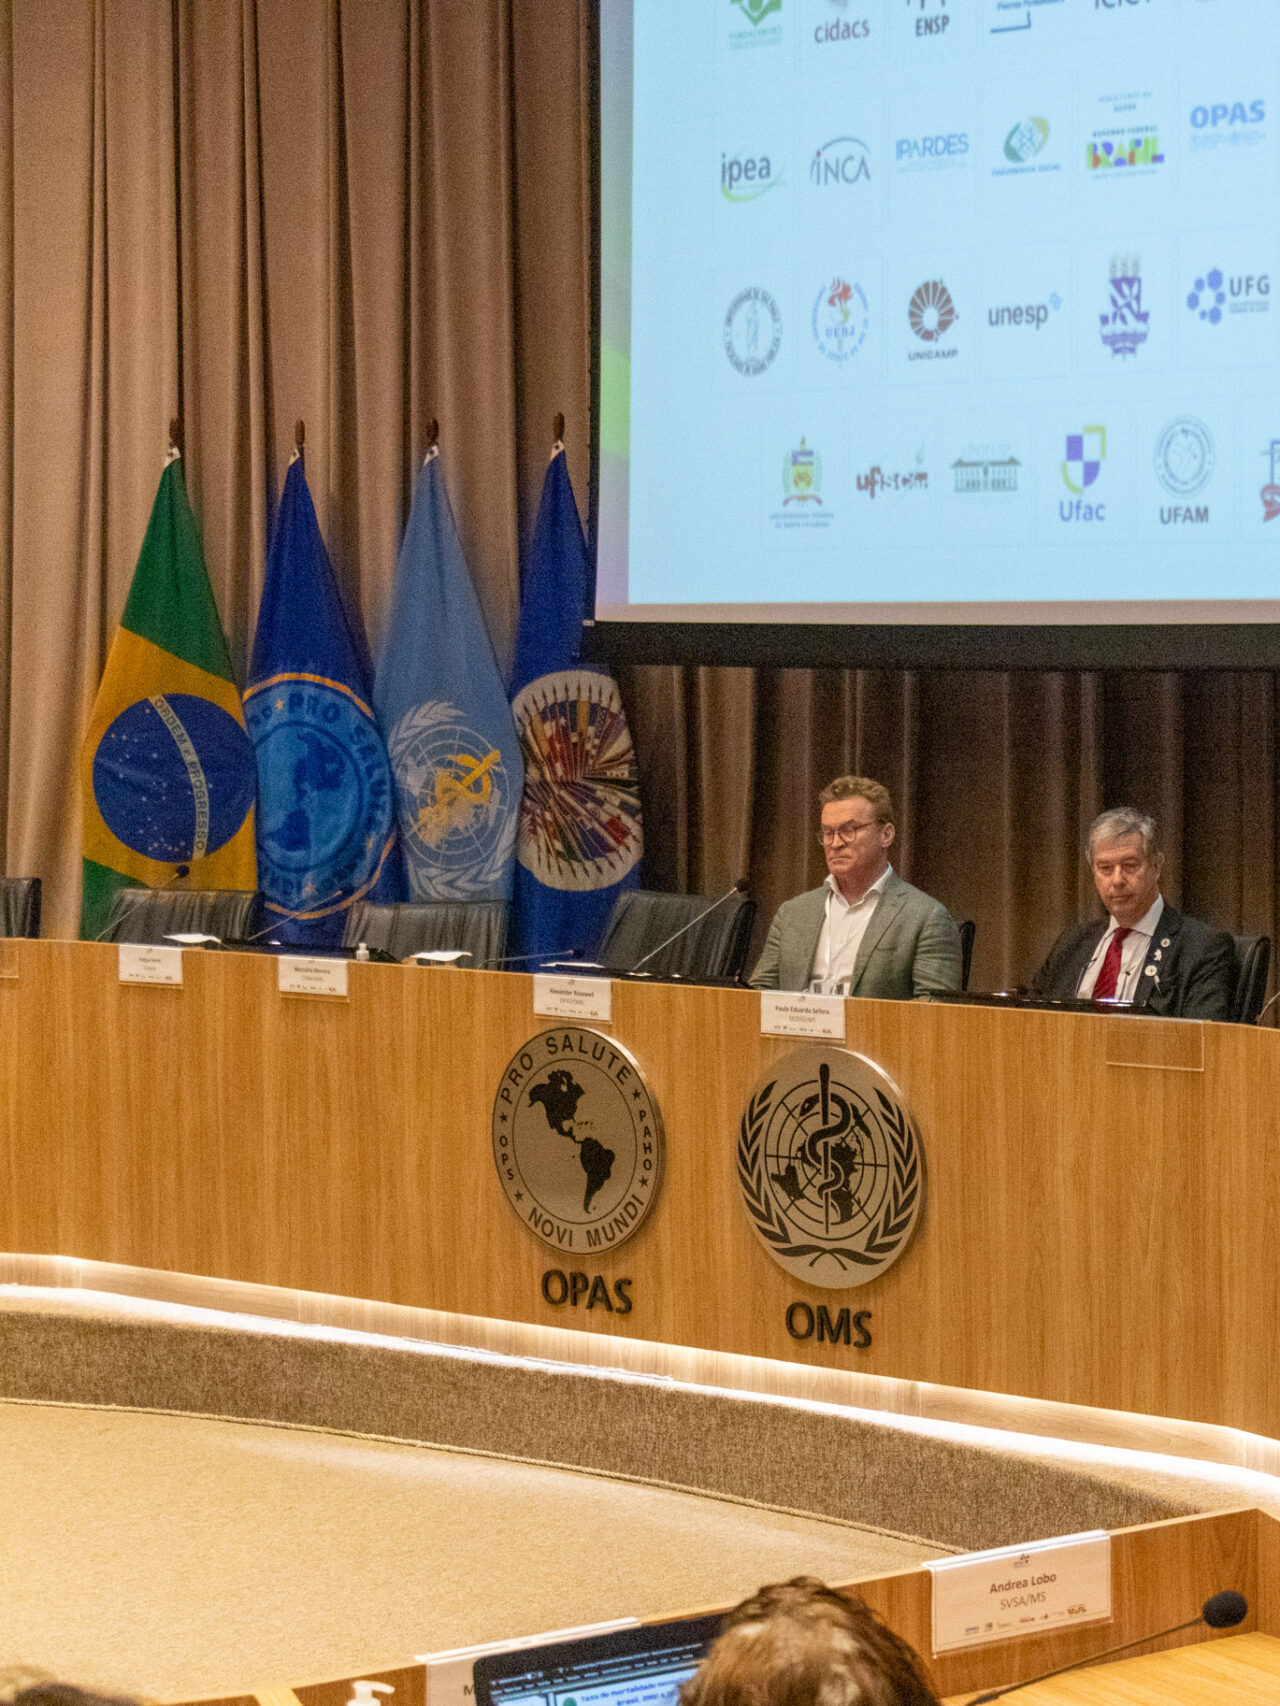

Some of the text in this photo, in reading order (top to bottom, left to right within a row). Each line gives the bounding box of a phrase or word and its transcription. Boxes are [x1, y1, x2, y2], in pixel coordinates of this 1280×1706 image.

[814, 18, 870, 43] cidacs
[915, 15, 950, 37] ENSP
[1190, 100, 1265, 129] OPAS
[896, 133, 968, 160] IPARDES
[721, 152, 771, 190] ipea
[1229, 274, 1270, 297] UFG
[988, 303, 1048, 330] unesp
[908, 349, 958, 361] UNICAMP
[1059, 500, 1105, 522] Ufac
[1160, 505, 1209, 525] UFAM
[288, 692, 341, 725] PRO
[154, 697, 188, 746] ORDEM
[189, 761, 208, 851] PROGRESSO
[501, 1034, 632, 1105] PRO SALUTE
[639, 1110, 652, 1171] PAHO
[499, 1135, 514, 1181] OPS
[528, 1193, 645, 1248] NOVI MUNDI
[540, 1269, 633, 1315] OPAS
[785, 1301, 873, 1348] OMS
[989, 1572, 1057, 1595] Andrea Lobo
[1000, 1590, 1047, 1610] SVSA/MS
[611, 1683, 656, 1697] mortalidade
